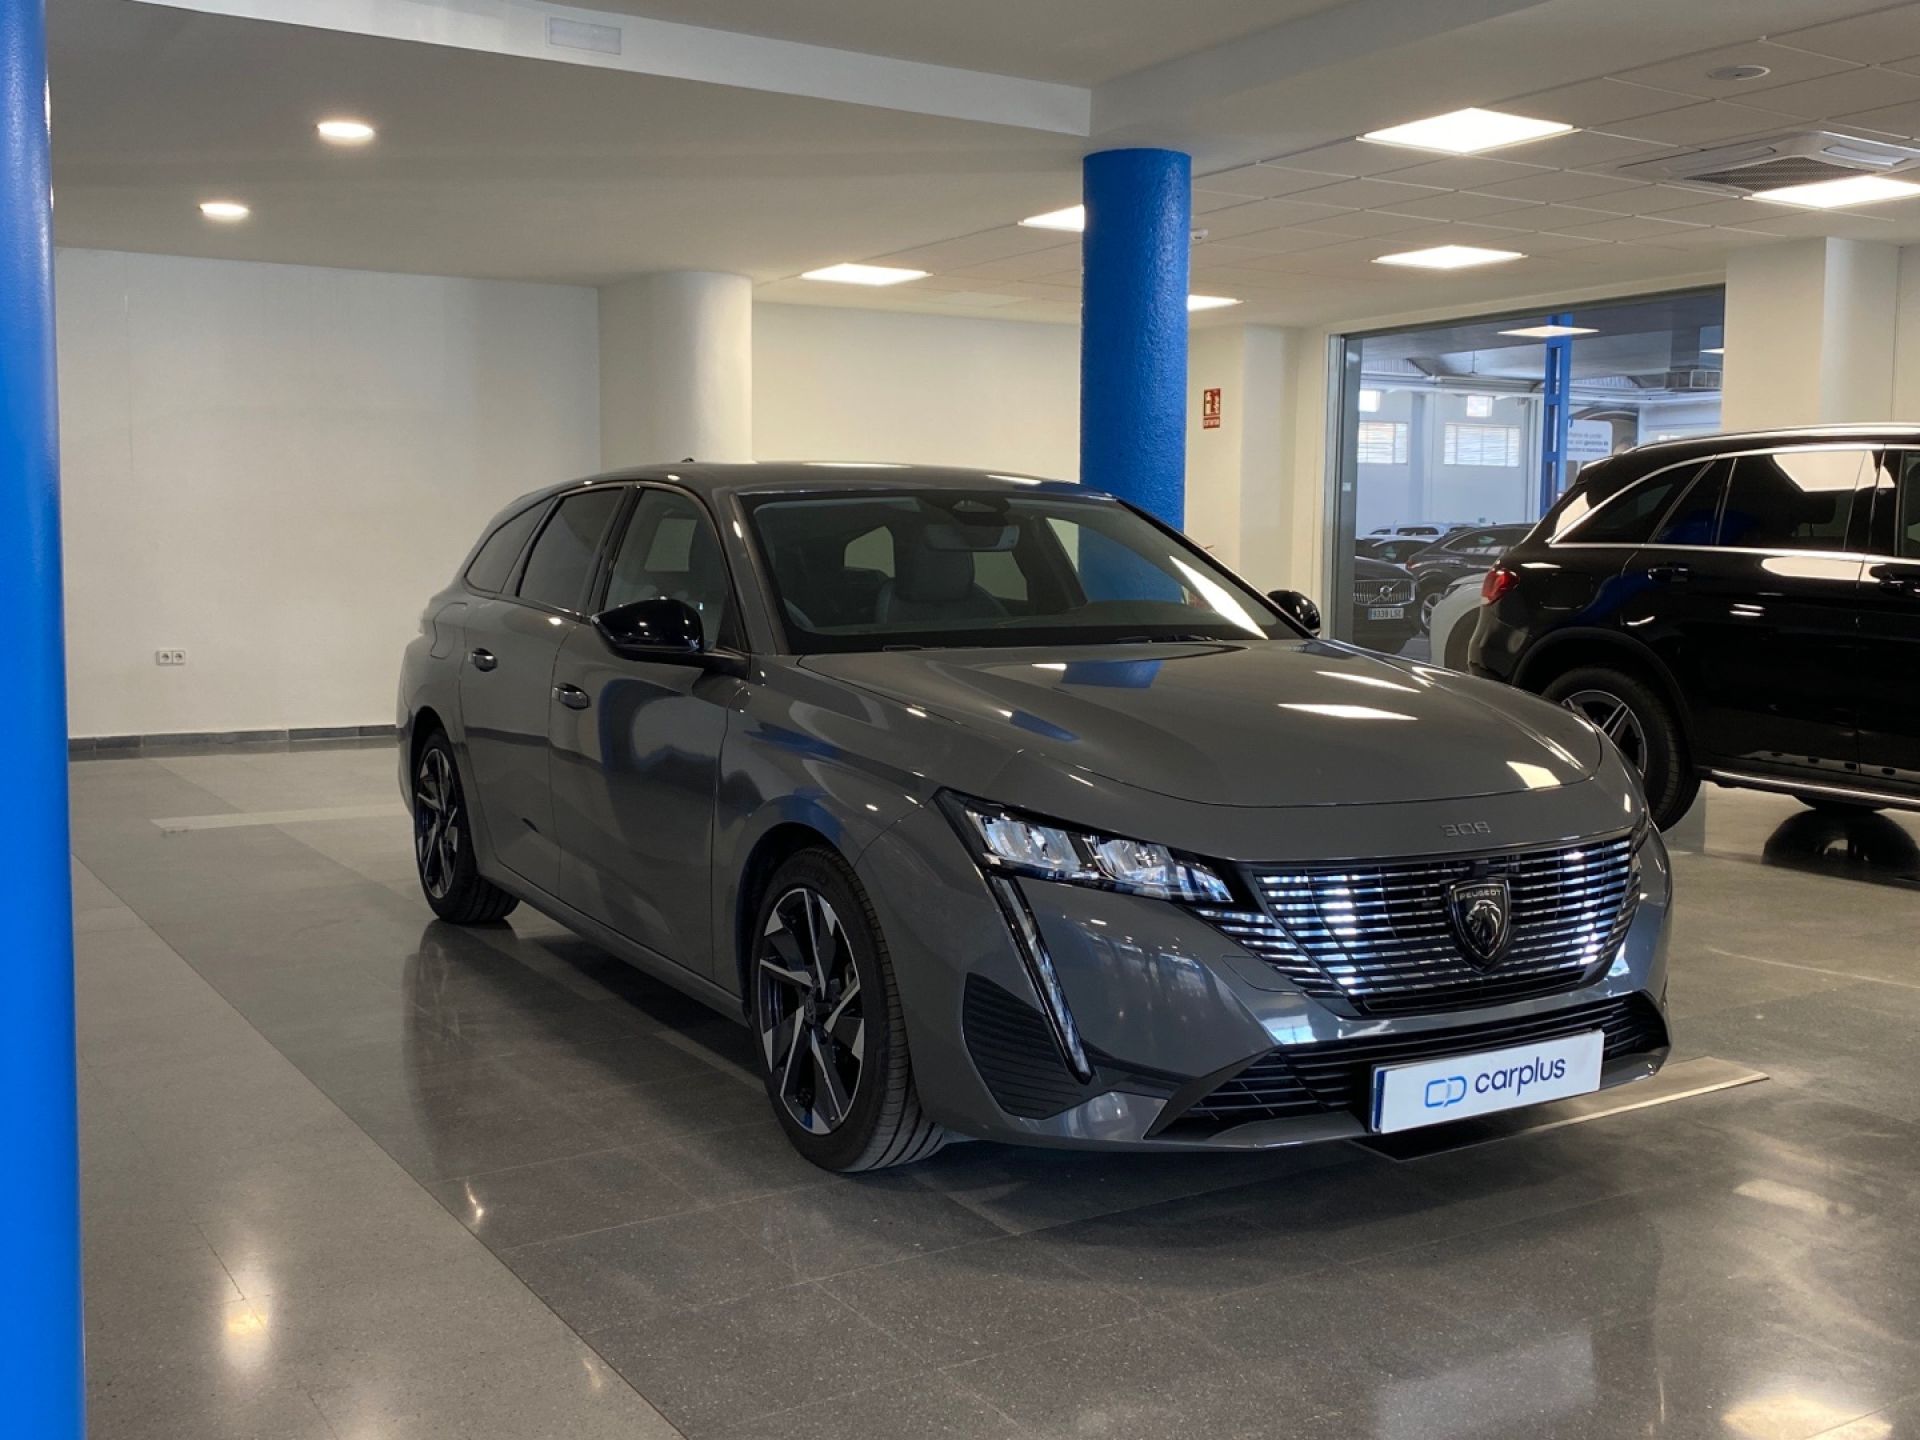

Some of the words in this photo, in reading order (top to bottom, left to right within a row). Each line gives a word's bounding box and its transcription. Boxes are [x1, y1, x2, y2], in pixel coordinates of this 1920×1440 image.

[1440, 821, 1490, 837] 308
[1459, 888, 1502, 901] PEUGEOT
[1475, 1056, 1566, 1096] carplus
